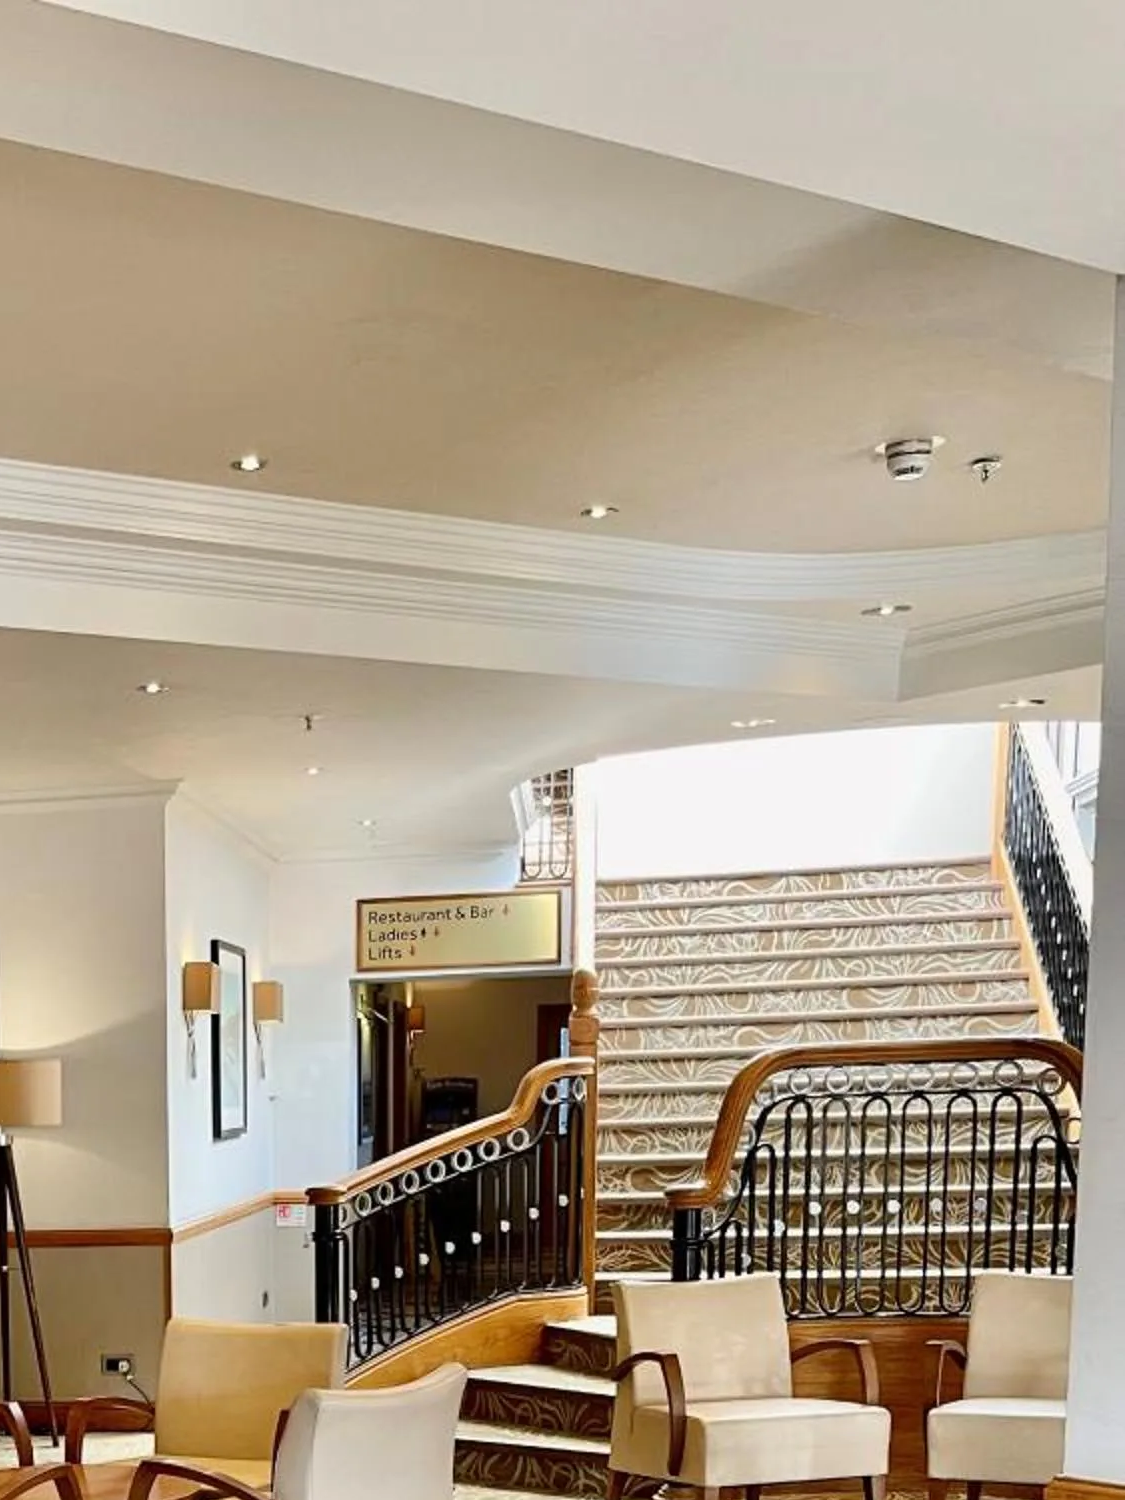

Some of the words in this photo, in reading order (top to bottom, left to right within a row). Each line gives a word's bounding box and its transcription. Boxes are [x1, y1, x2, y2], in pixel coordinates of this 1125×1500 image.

[368, 907, 452, 925] Restaurant
[455, 906, 466, 920] &
[470, 904, 494, 919] Bar
[368, 928, 417, 943] Ladies
[368, 945, 403, 961] Lifts
